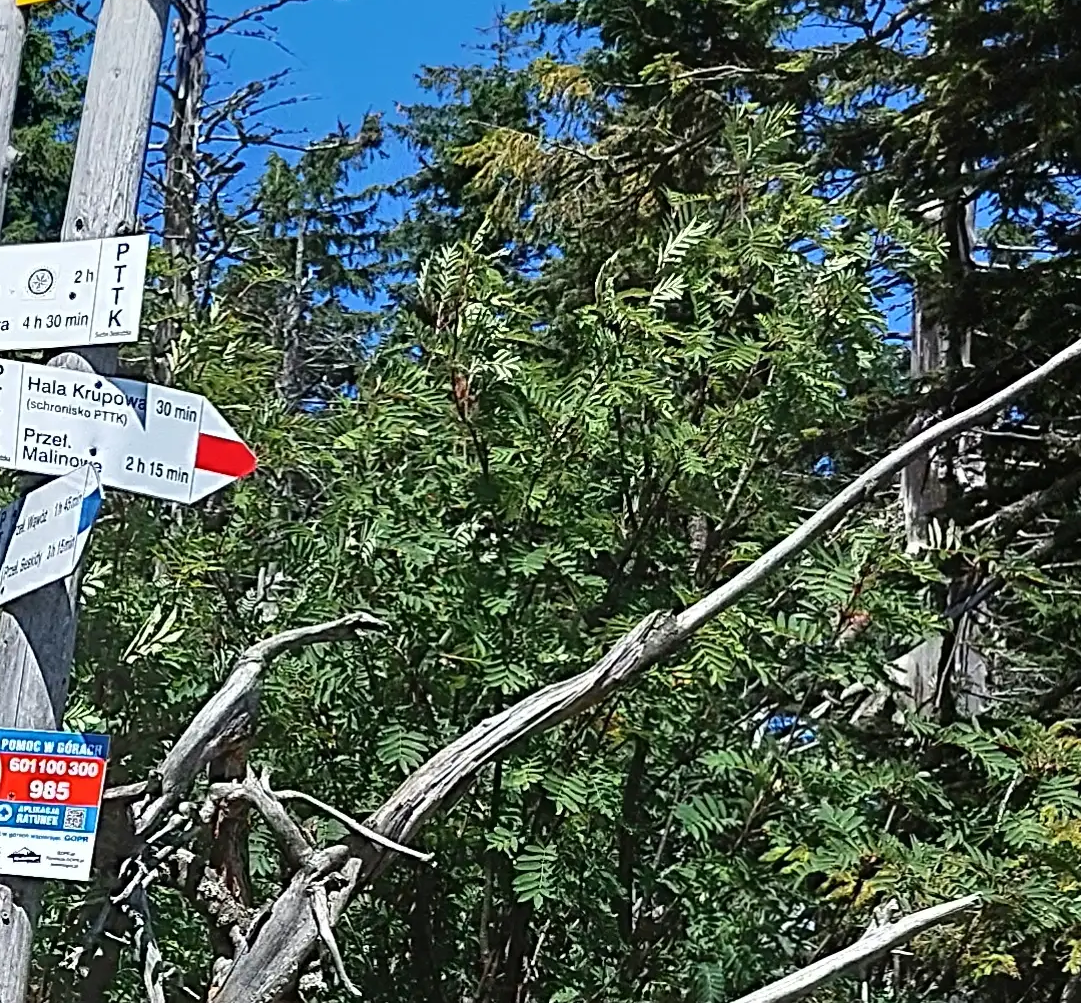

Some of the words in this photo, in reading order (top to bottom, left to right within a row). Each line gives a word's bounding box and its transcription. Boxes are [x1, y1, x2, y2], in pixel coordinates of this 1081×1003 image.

[74, 270, 83, 284] 2
[85, 269, 94, 283] h
[22, 316, 31, 329] 4
[34, 315, 42, 329] h
[45, 314, 62, 328] 30
[65, 313, 89, 327] min
[27, 376, 67, 397] Hala
[73, 383, 147, 410] Krupowa
[156, 399, 172, 417] 30
[174, 404, 198, 423] min
[26, 401, 91, 419] (schronisko
[95, 411, 128, 427] PTTK)
[24, 427, 72, 449] Przeł.
[125, 456, 134, 470] 2
[137, 458, 145, 473] h
[149, 461, 164, 477] 15
[167, 465, 189, 484] min
[1, 738, 41, 753] POMOC
[44, 741, 55, 754] W
[57, 740, 103, 756] GÓRACH
[9, 757, 37, 774] 601
[39, 759, 67, 776] 100
[68, 761, 99, 778] 300
[29, 779, 71, 801] 985
[15, 813, 59, 826] RATUNEK
[64, 834, 89, 843] GOPR
